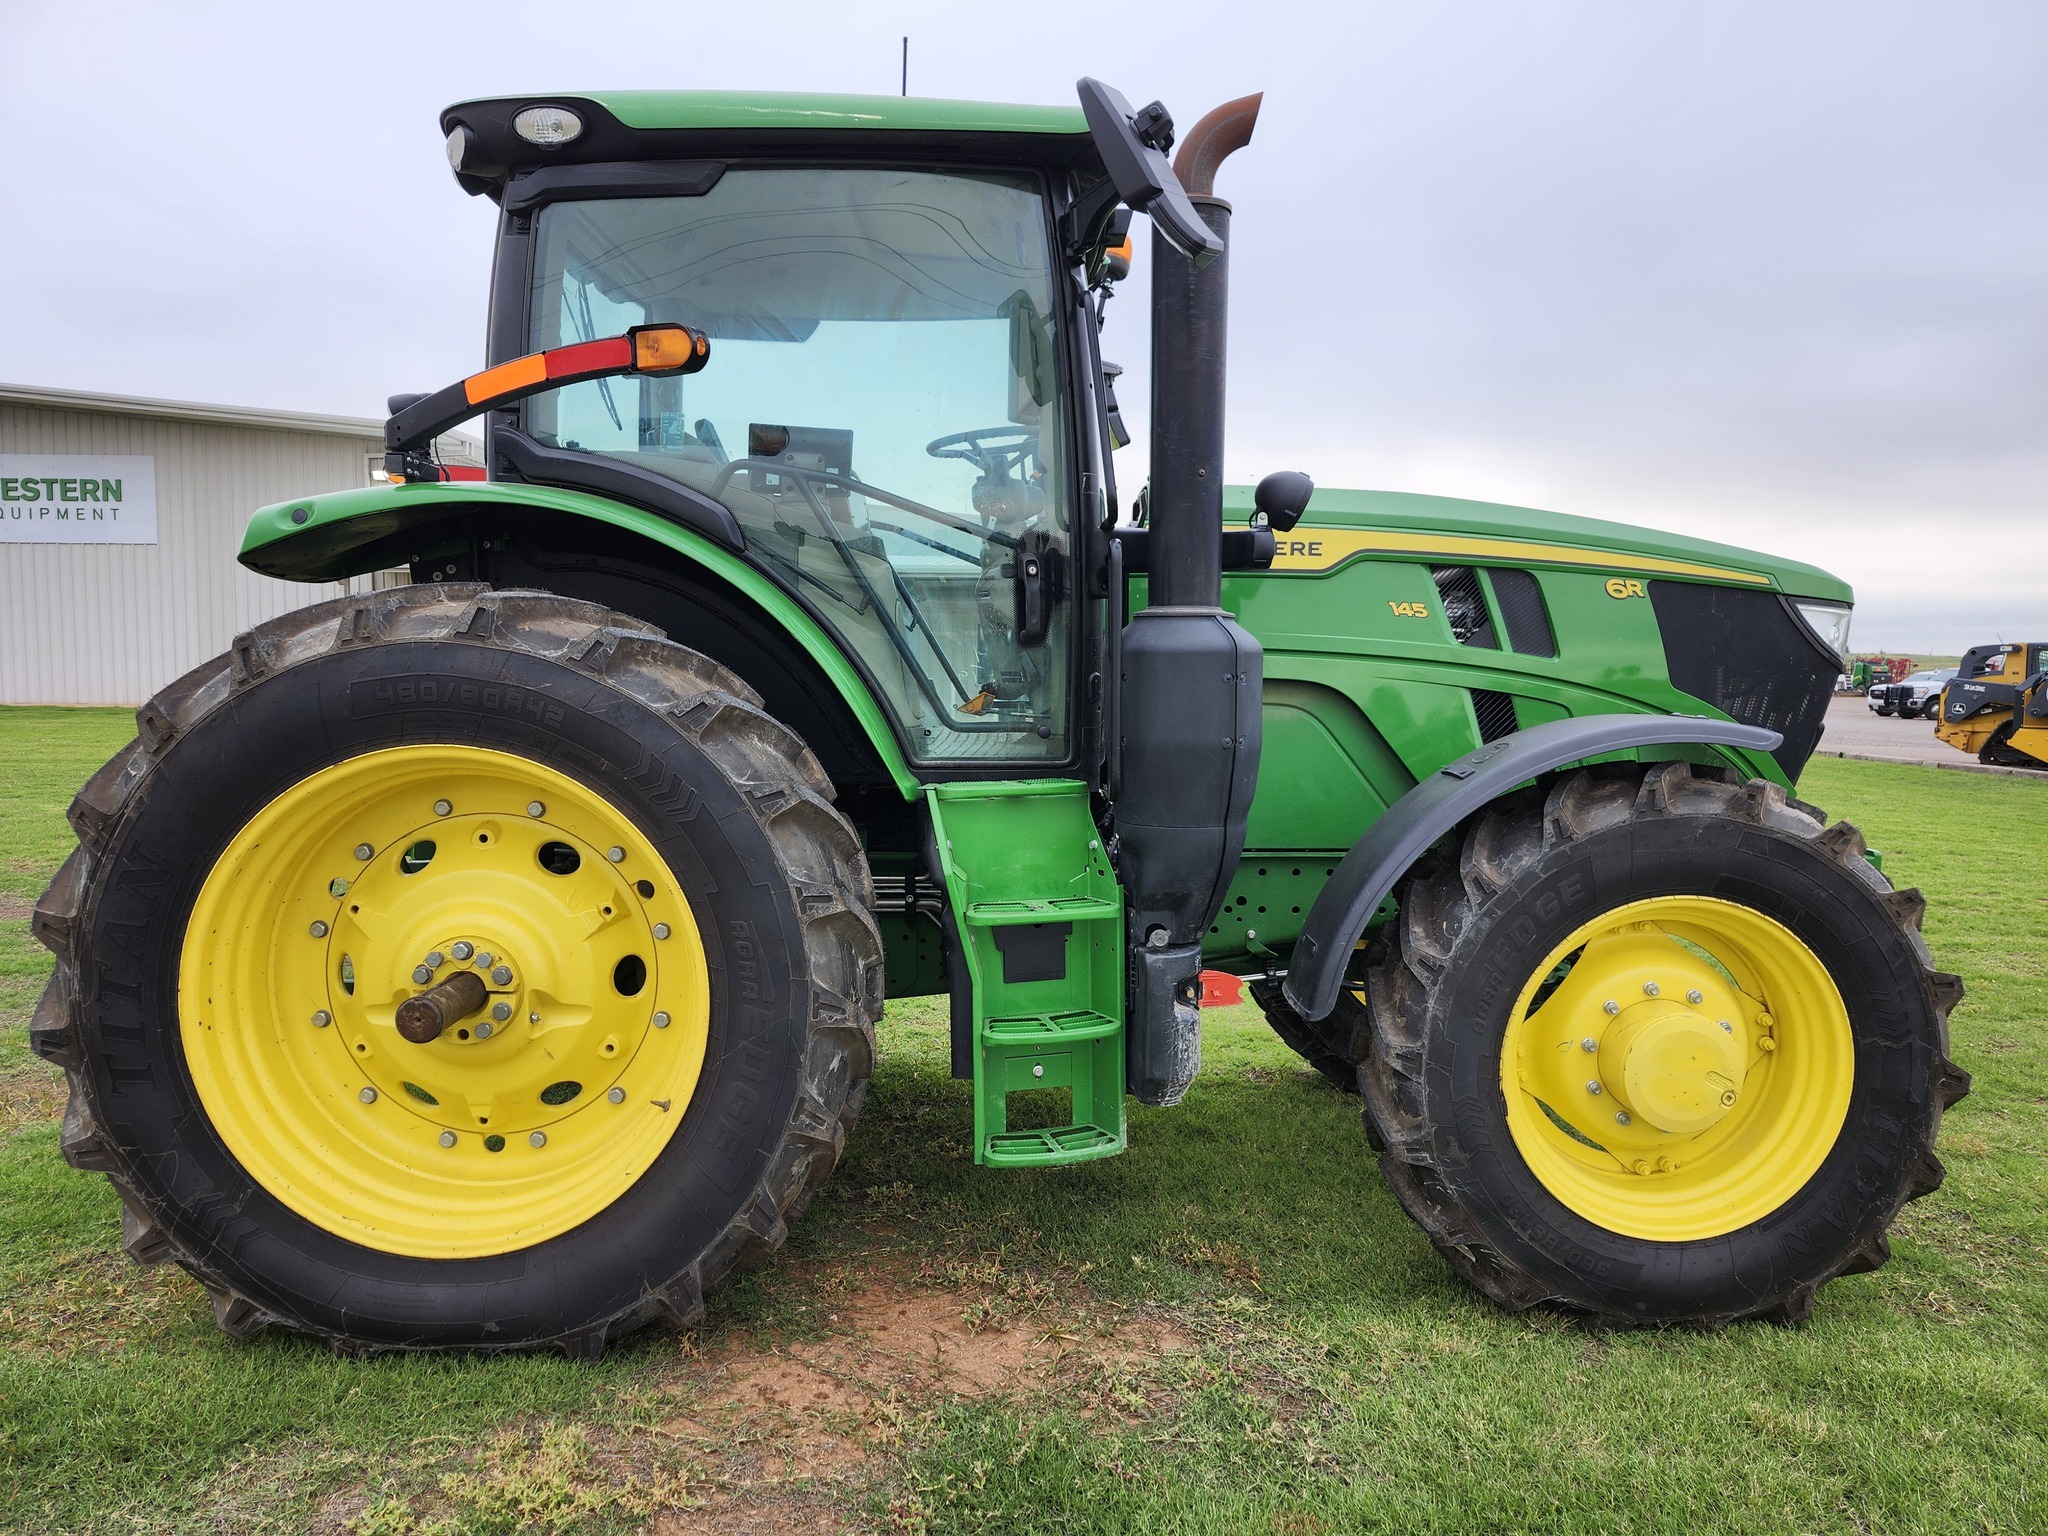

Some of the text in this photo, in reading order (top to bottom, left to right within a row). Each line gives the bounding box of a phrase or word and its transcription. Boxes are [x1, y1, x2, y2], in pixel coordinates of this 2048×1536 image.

[0, 478, 122, 501] ESTERN
[1274, 541, 1322, 556] ERE
[1605, 578, 1645, 600] 6R
[1388, 601, 1428, 618] 145
[374, 680, 567, 730] 480/80R42
[95, 839, 173, 1097] TITAN
[1778, 1104, 1908, 1265] TITAN
